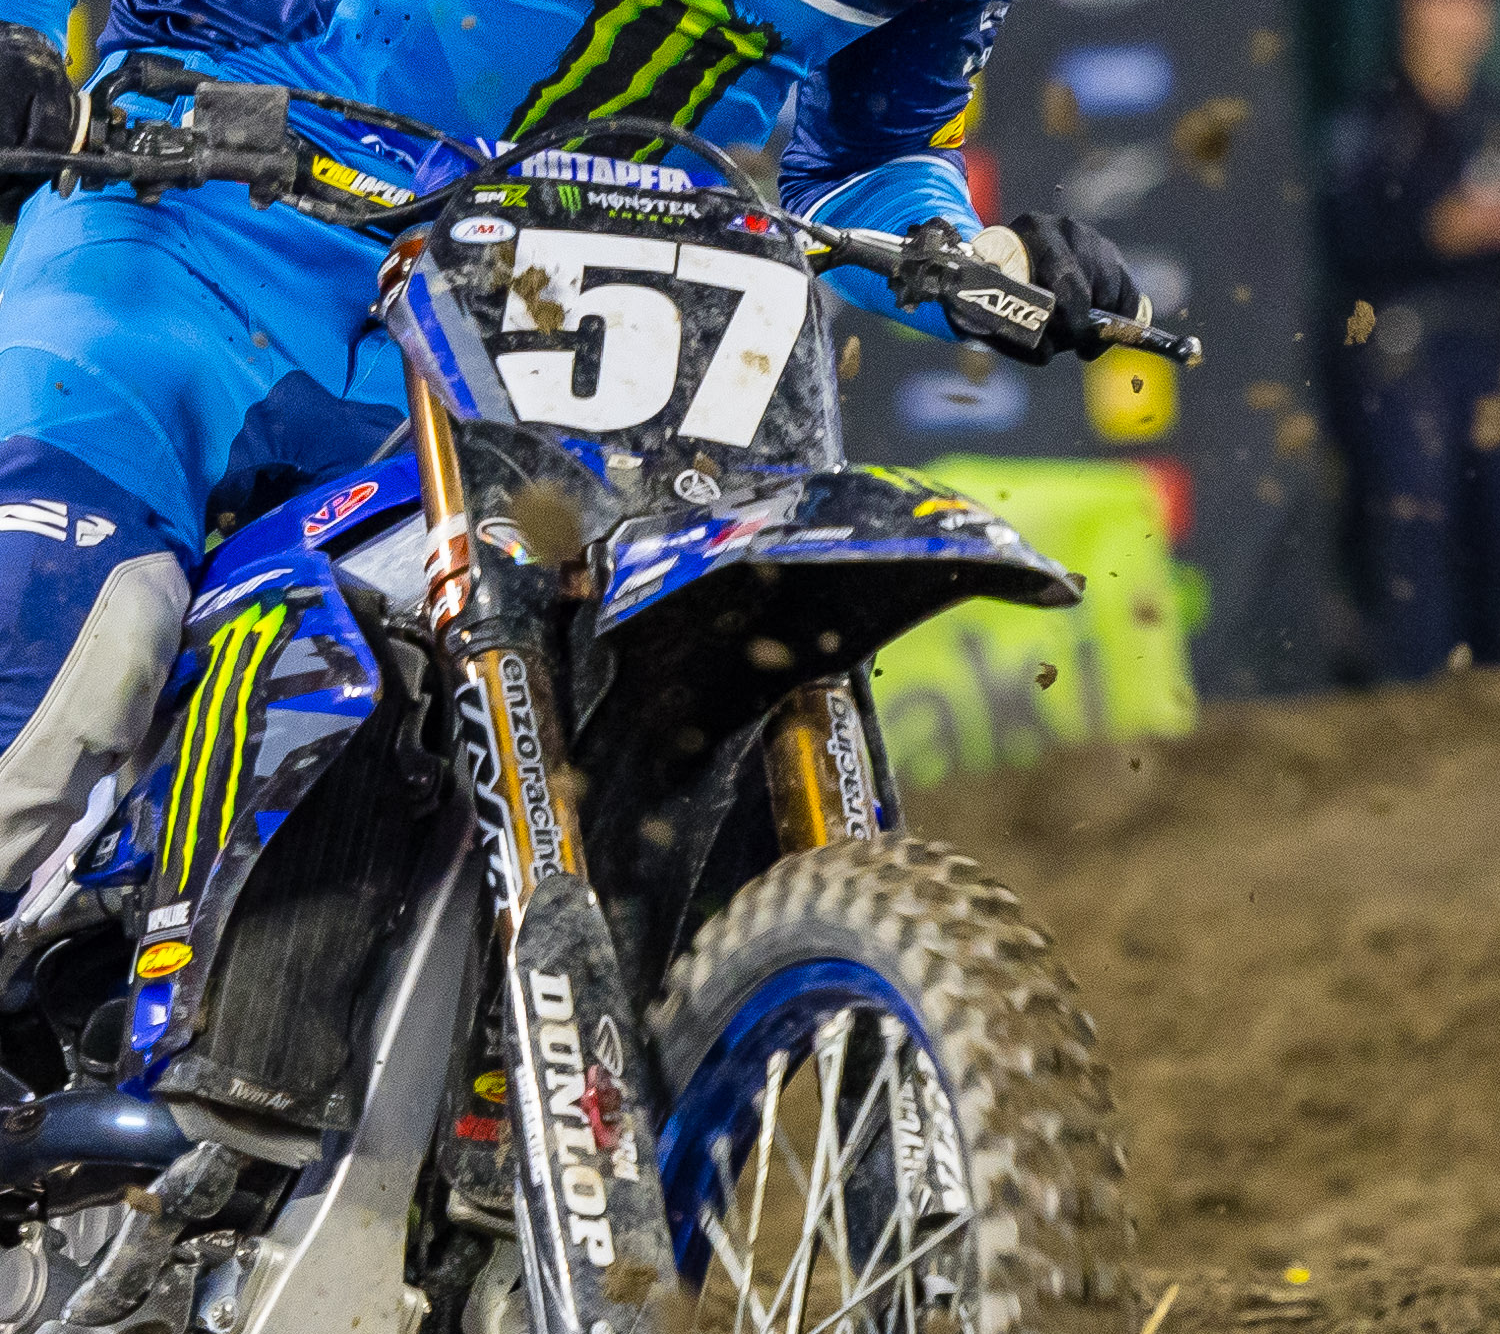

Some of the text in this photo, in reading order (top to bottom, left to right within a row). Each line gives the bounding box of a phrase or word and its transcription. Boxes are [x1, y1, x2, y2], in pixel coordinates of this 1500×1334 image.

[587, 191, 701, 219] MONSTER
[496, 229, 808, 448] 57
[956, 288, 1051, 332] ARC
[529, 968, 617, 1268] DUNLOP
